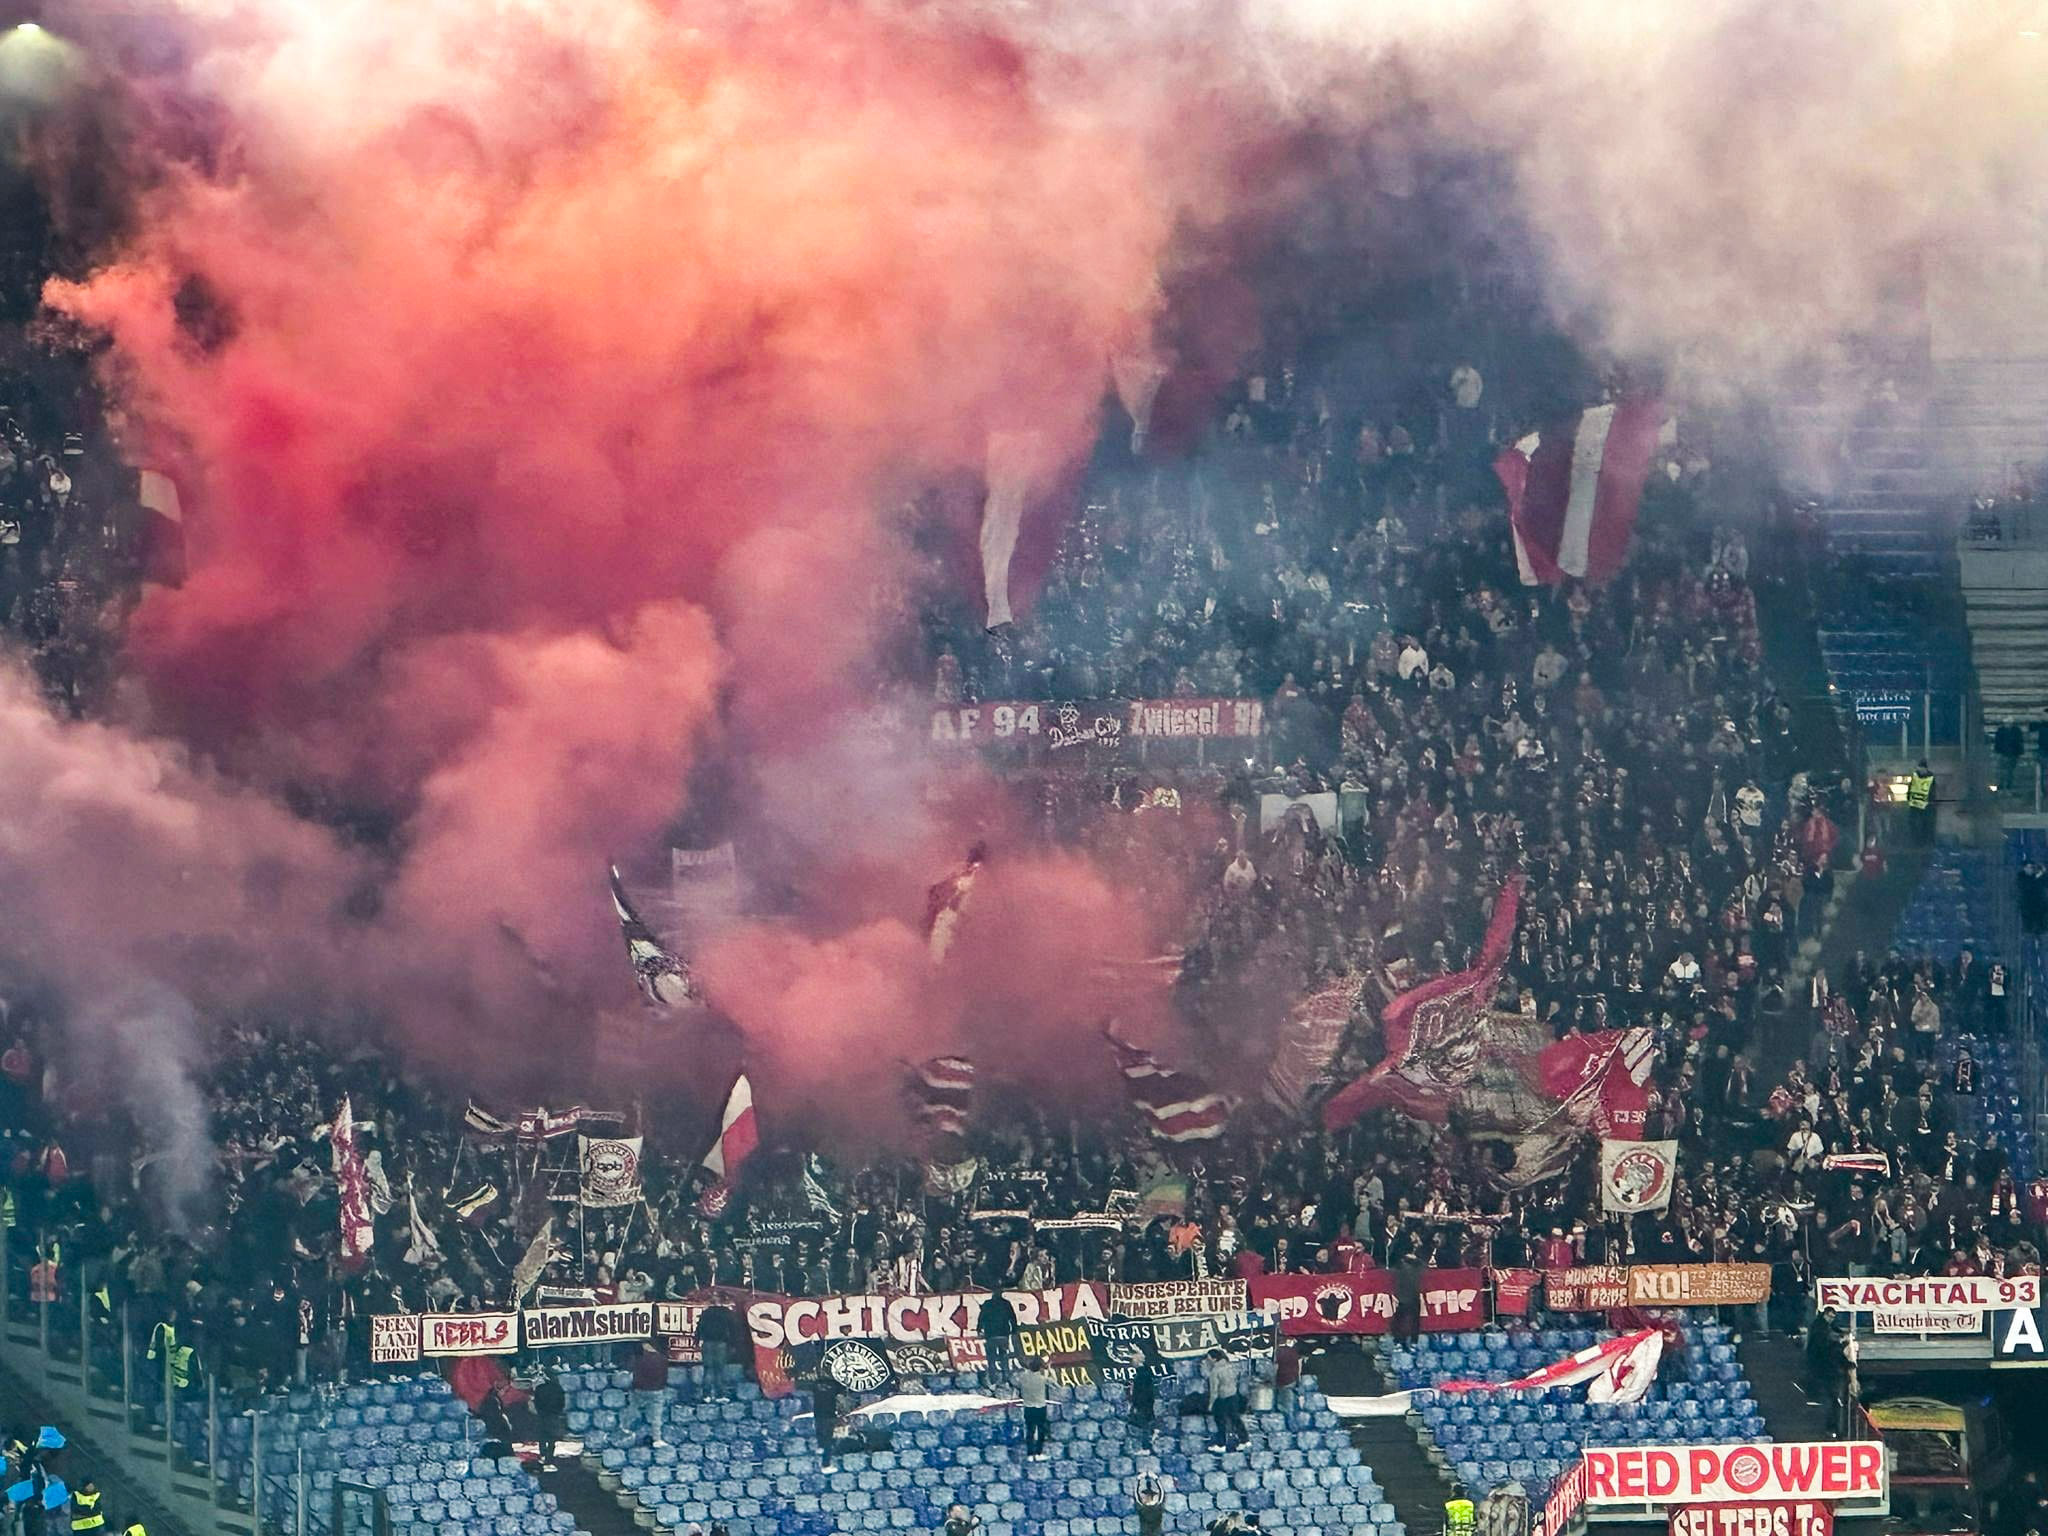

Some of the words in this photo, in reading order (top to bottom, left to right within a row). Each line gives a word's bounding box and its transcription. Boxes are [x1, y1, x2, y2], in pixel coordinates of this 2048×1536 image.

[993, 705, 1040, 737] 94
[1112, 1279, 1246, 1299] AUSGESPERRTE
[1633, 1270, 1690, 1299] NO!
[1822, 1282, 1989, 1306] EYACHTAL
[1999, 1281, 2036, 1303] 93
[1112, 1299, 1169, 1317] IMMER
[1174, 1297, 1202, 1314] BEI
[1208, 1296, 1243, 1312] UNS
[374, 1318, 417, 1332] SEEN
[527, 1307, 651, 1341] alarMstufe
[1089, 1320, 1151, 1341] ULTRAS
[1876, 1312, 1951, 1331] Altenburg
[2002, 1307, 2045, 1353] A
[374, 1333, 417, 1348] LAND
[434, 1319, 509, 1348] REBELS
[1020, 1325, 1092, 1356] BANDA
[374, 1348, 416, 1360] FRONT
[1102, 1363, 1169, 1381] EMPLI
[1587, 1451, 1680, 1498] RED
[1689, 1445, 1881, 1495] POWER
